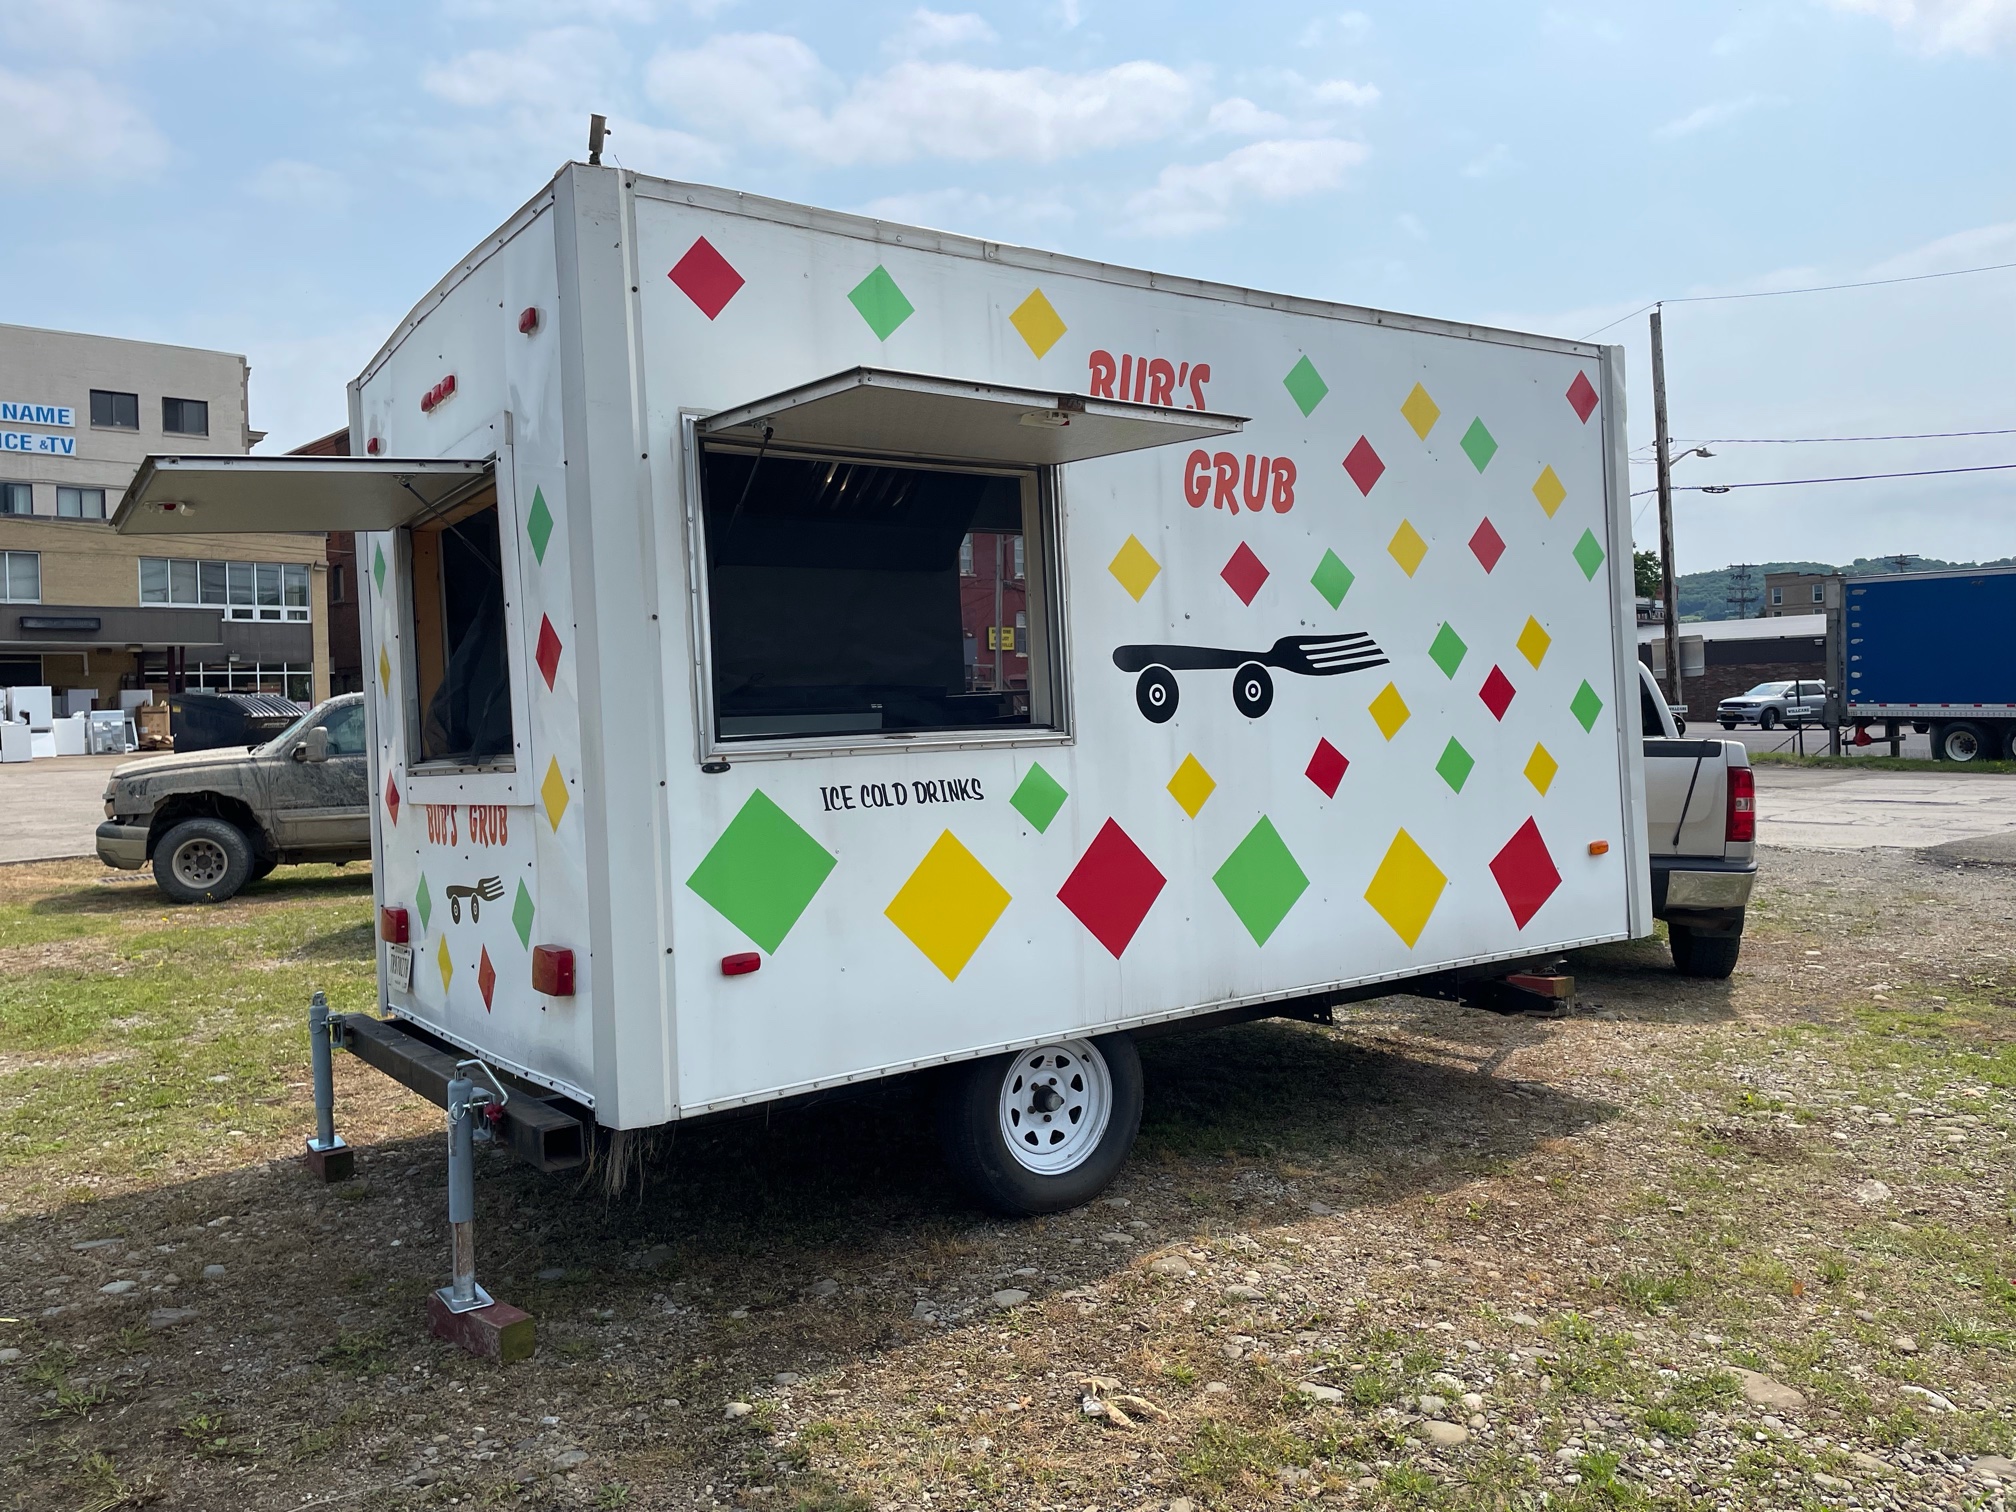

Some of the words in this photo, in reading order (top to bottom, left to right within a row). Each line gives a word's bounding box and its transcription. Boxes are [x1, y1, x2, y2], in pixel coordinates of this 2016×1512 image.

[2, 403, 70, 424] NAME
[1184, 449, 1297, 515] GRUB
[819, 786, 856, 812] ICE
[860, 782, 908, 808] COLD
[911, 777, 985, 804] DRINKS
[468, 804, 508, 849] GRUB
